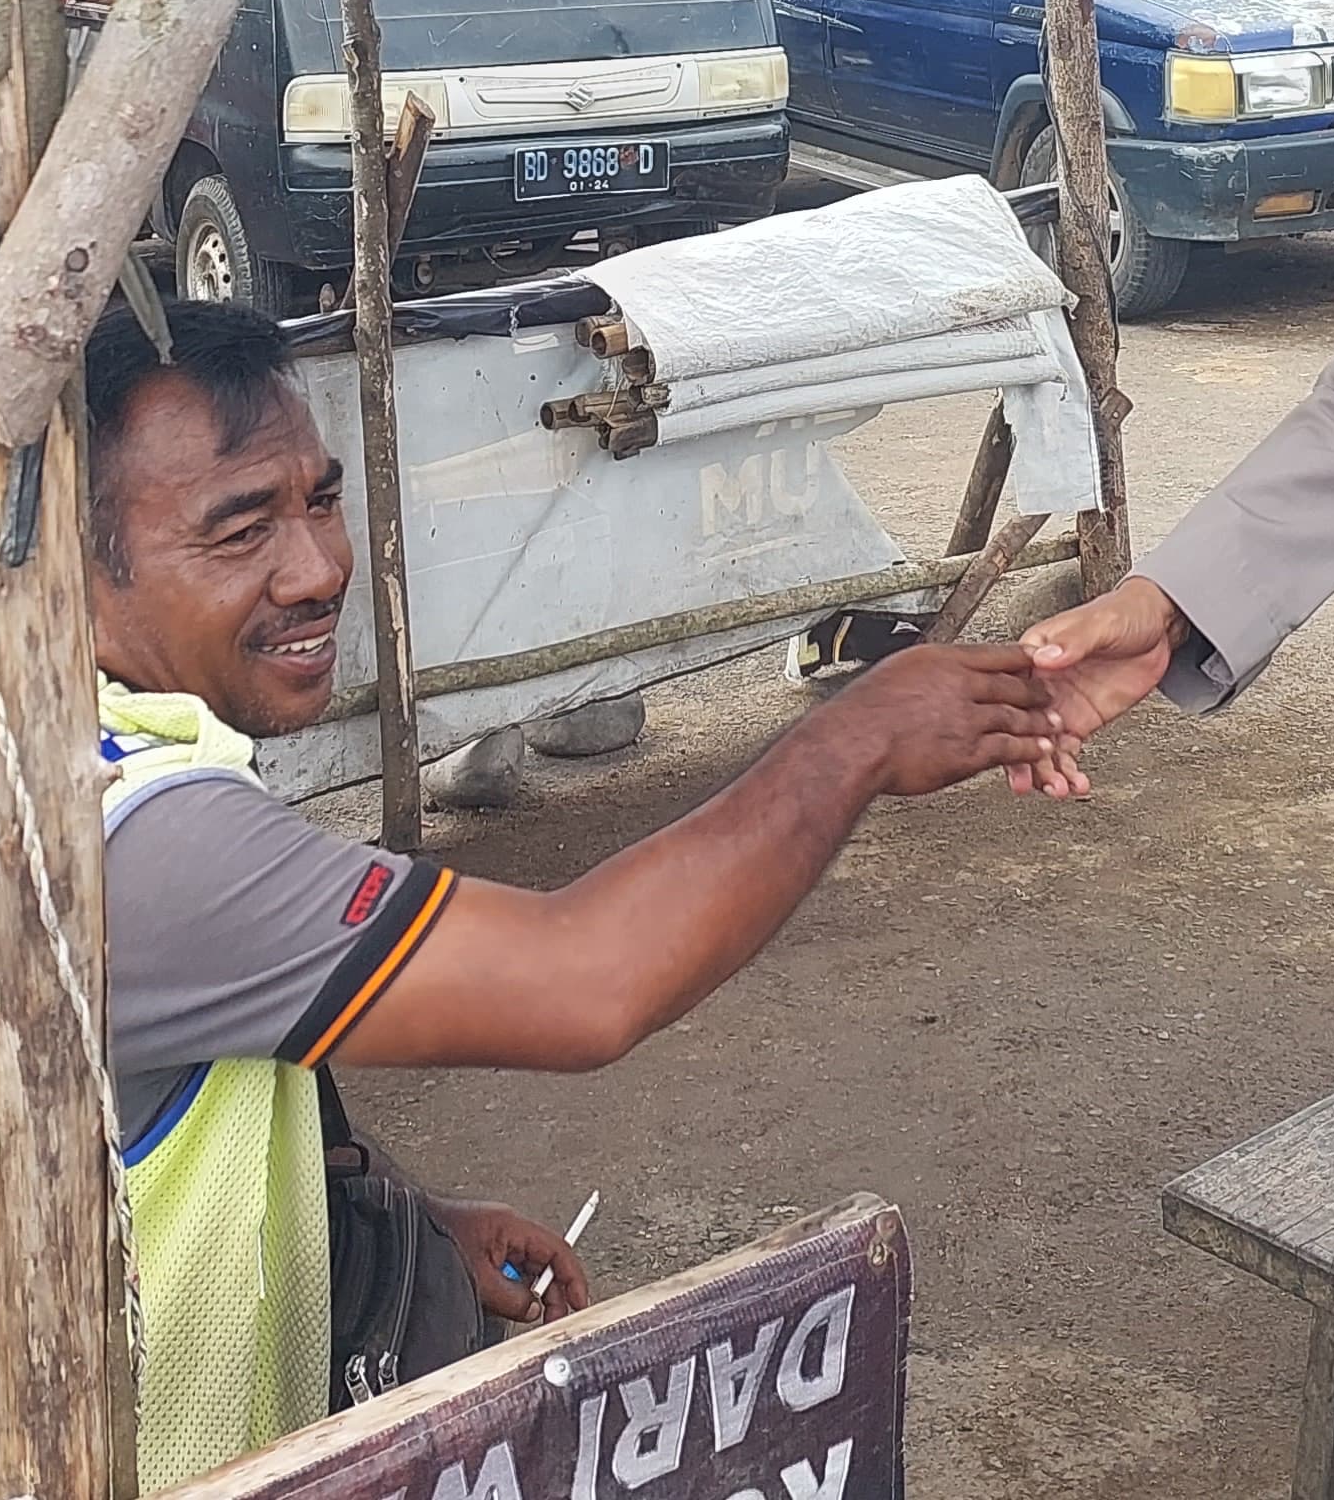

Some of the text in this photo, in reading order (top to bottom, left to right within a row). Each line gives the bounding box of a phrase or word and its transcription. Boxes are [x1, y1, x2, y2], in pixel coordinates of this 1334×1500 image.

[524, 144, 654, 182] BD 9868 D
[572, 1282, 856, 1500] DARI
